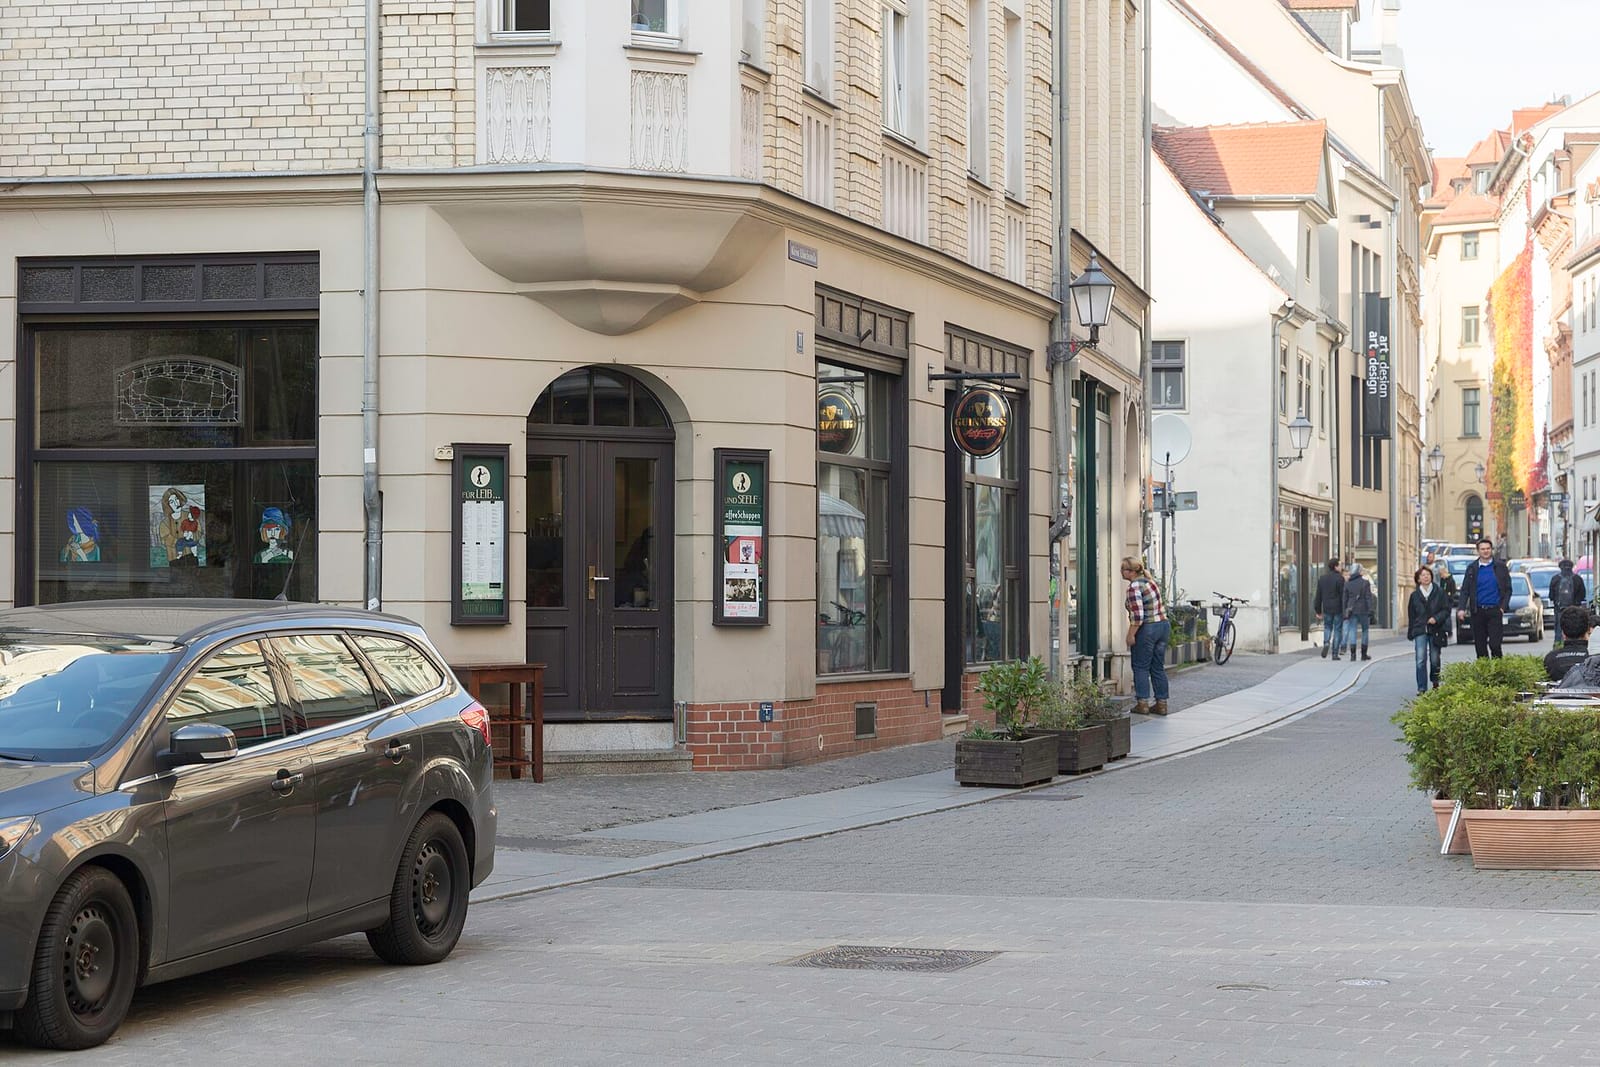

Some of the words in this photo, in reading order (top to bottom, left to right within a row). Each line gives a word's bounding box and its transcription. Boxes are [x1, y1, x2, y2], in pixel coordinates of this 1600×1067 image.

[1369, 330, 1379, 349] art
[1379, 335, 1389, 353] art
[1367, 357, 1379, 394] design
[955, 416, 1007, 427] GUINNESS
[725, 509, 761, 520] affeeSchuppen
